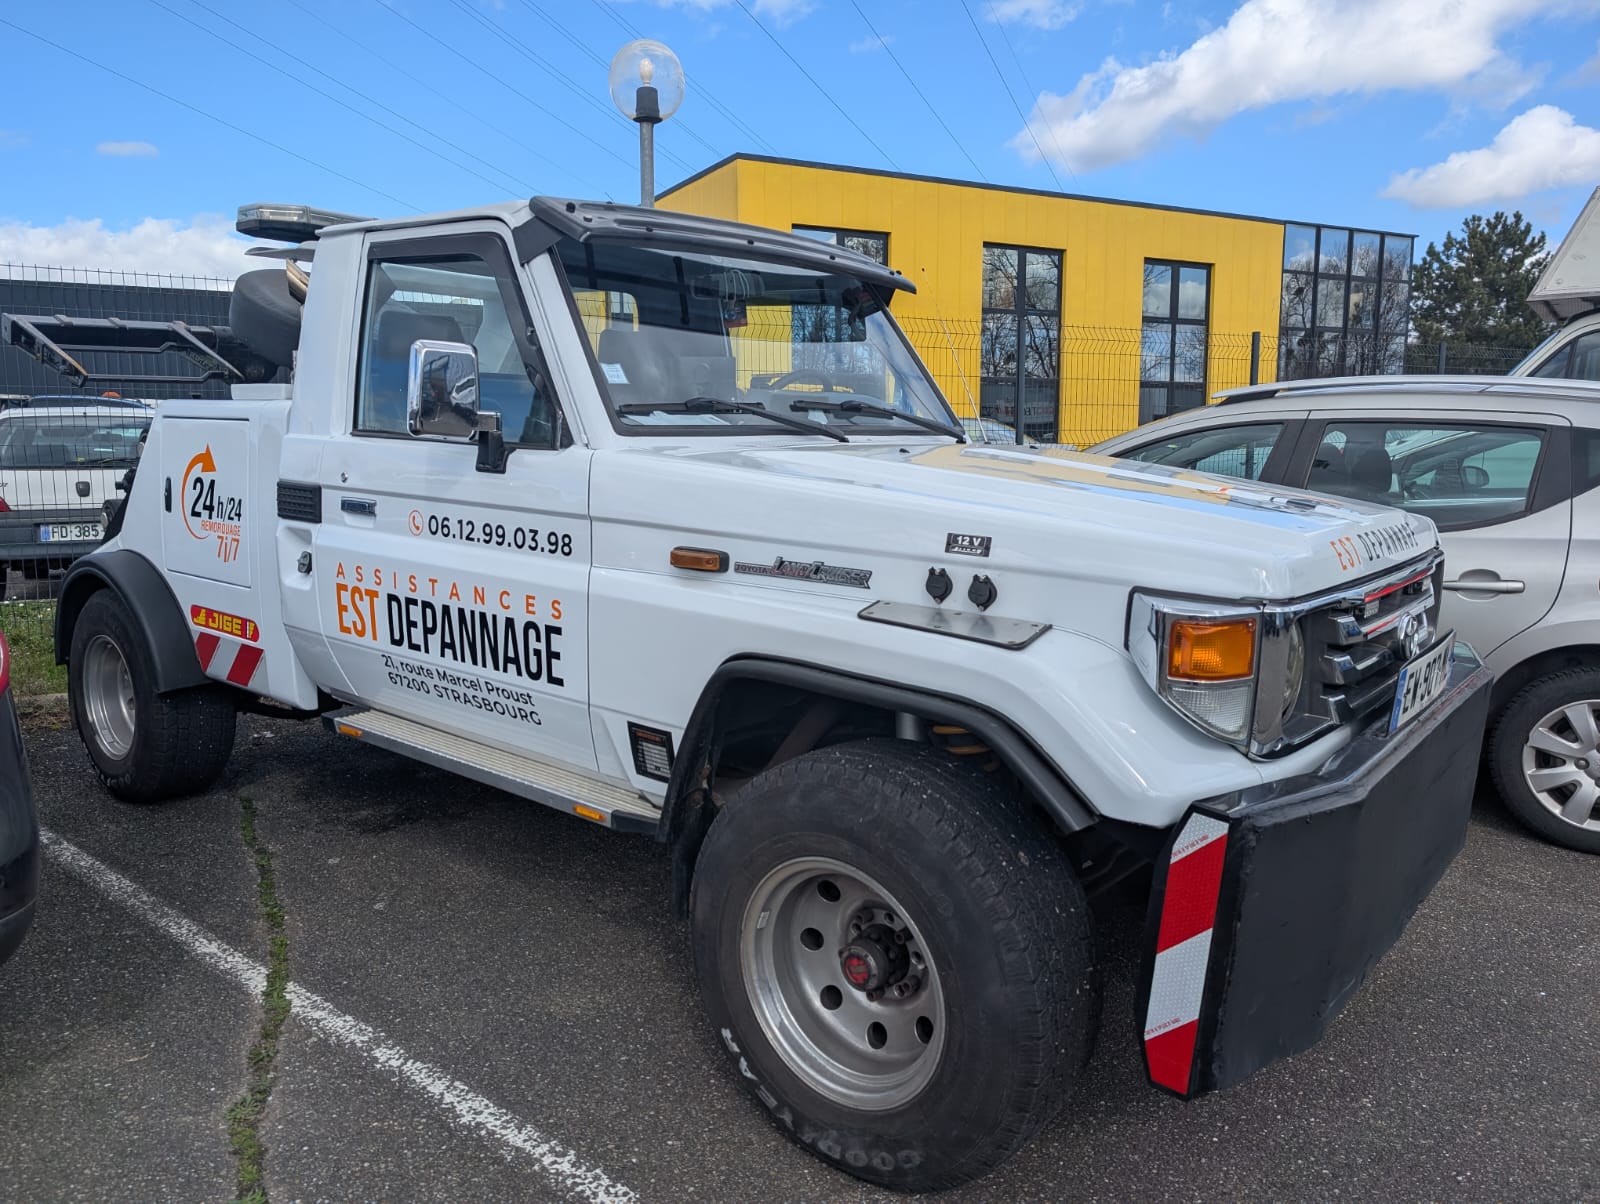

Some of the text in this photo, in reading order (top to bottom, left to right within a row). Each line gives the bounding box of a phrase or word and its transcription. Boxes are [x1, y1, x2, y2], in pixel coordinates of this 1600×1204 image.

[191, 476, 242, 522] 24 h/24
[201, 520, 241, 536] REMORQUAGE
[217, 535, 240, 563] 7j/7
[428, 514, 572, 557] 06.12.99.03.98
[956, 535, 982, 546] 12 V
[1329, 522, 1418, 571] EST DEPANNAGE
[336, 562, 563, 620] ASSISTANCES
[736, 564, 768, 574] TOYOTA
[209, 612, 242, 635] JIGE
[336, 582, 565, 687] EST DEPANNAGE
[381, 654, 535, 707] 21, route Marcel Proust
[388, 671, 543, 726] 67200 STRASBOURG
